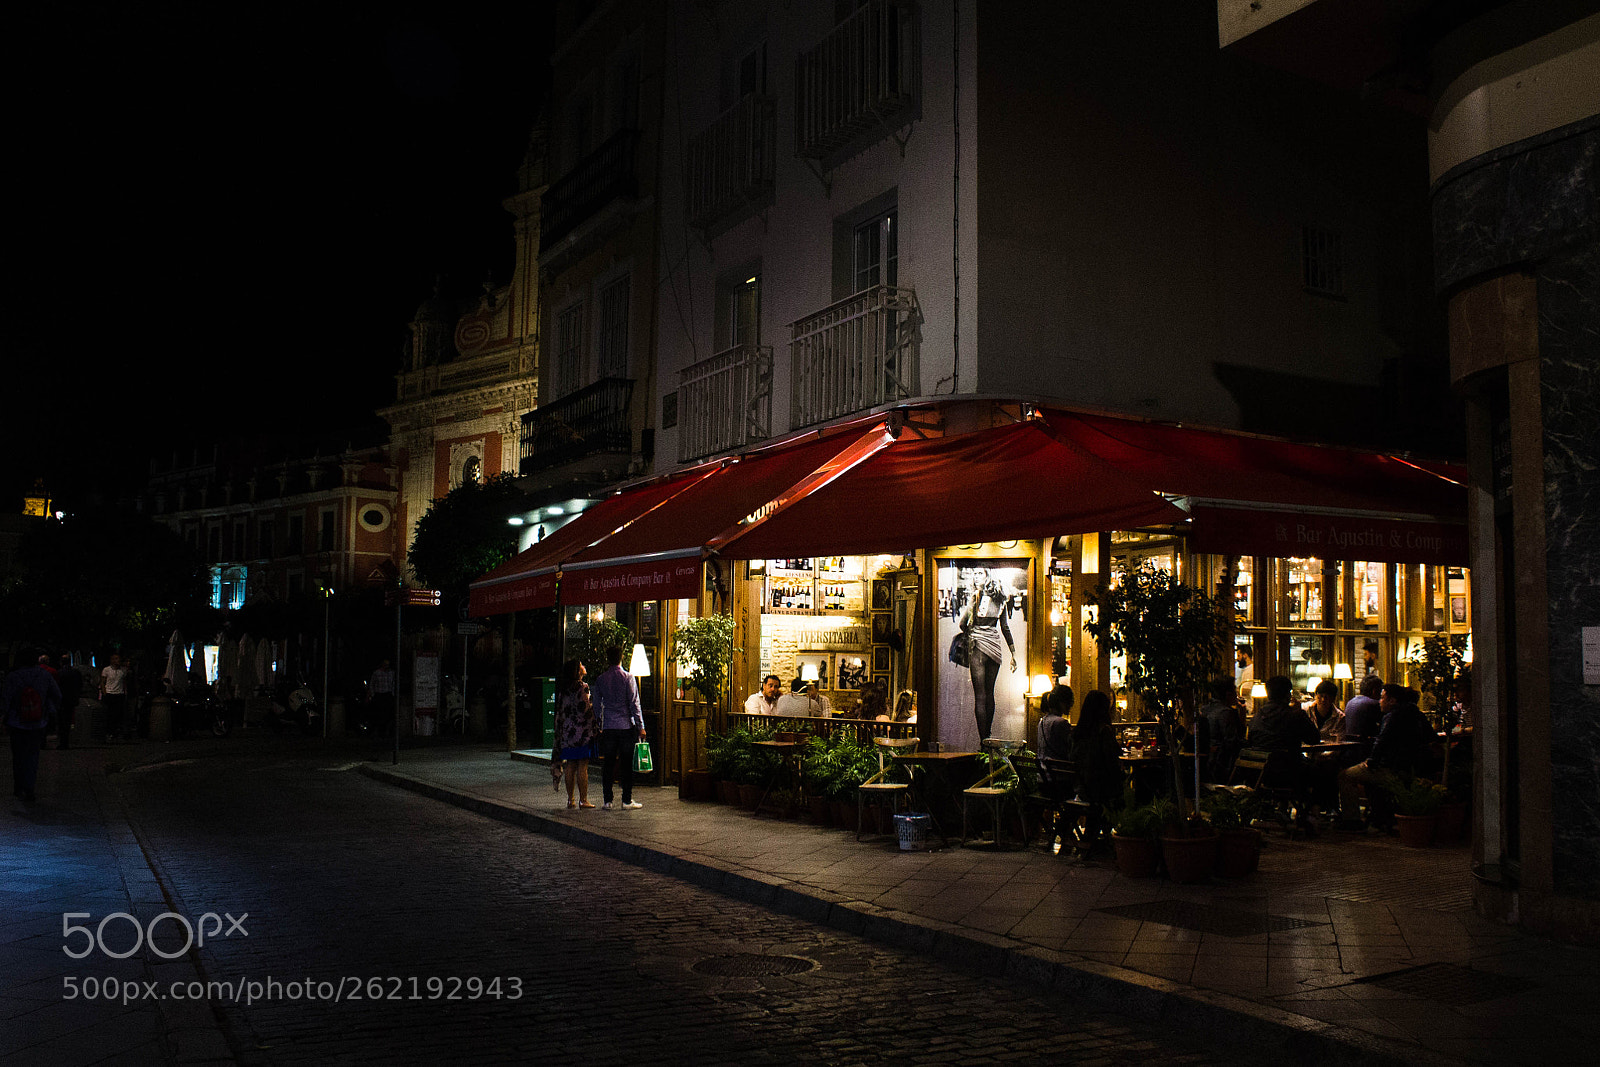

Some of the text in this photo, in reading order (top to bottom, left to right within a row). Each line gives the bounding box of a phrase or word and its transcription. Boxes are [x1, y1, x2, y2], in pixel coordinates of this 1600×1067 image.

[1296, 524, 1468, 556] Bar Agustin & Comp
[653, 571, 664, 584] Bar
